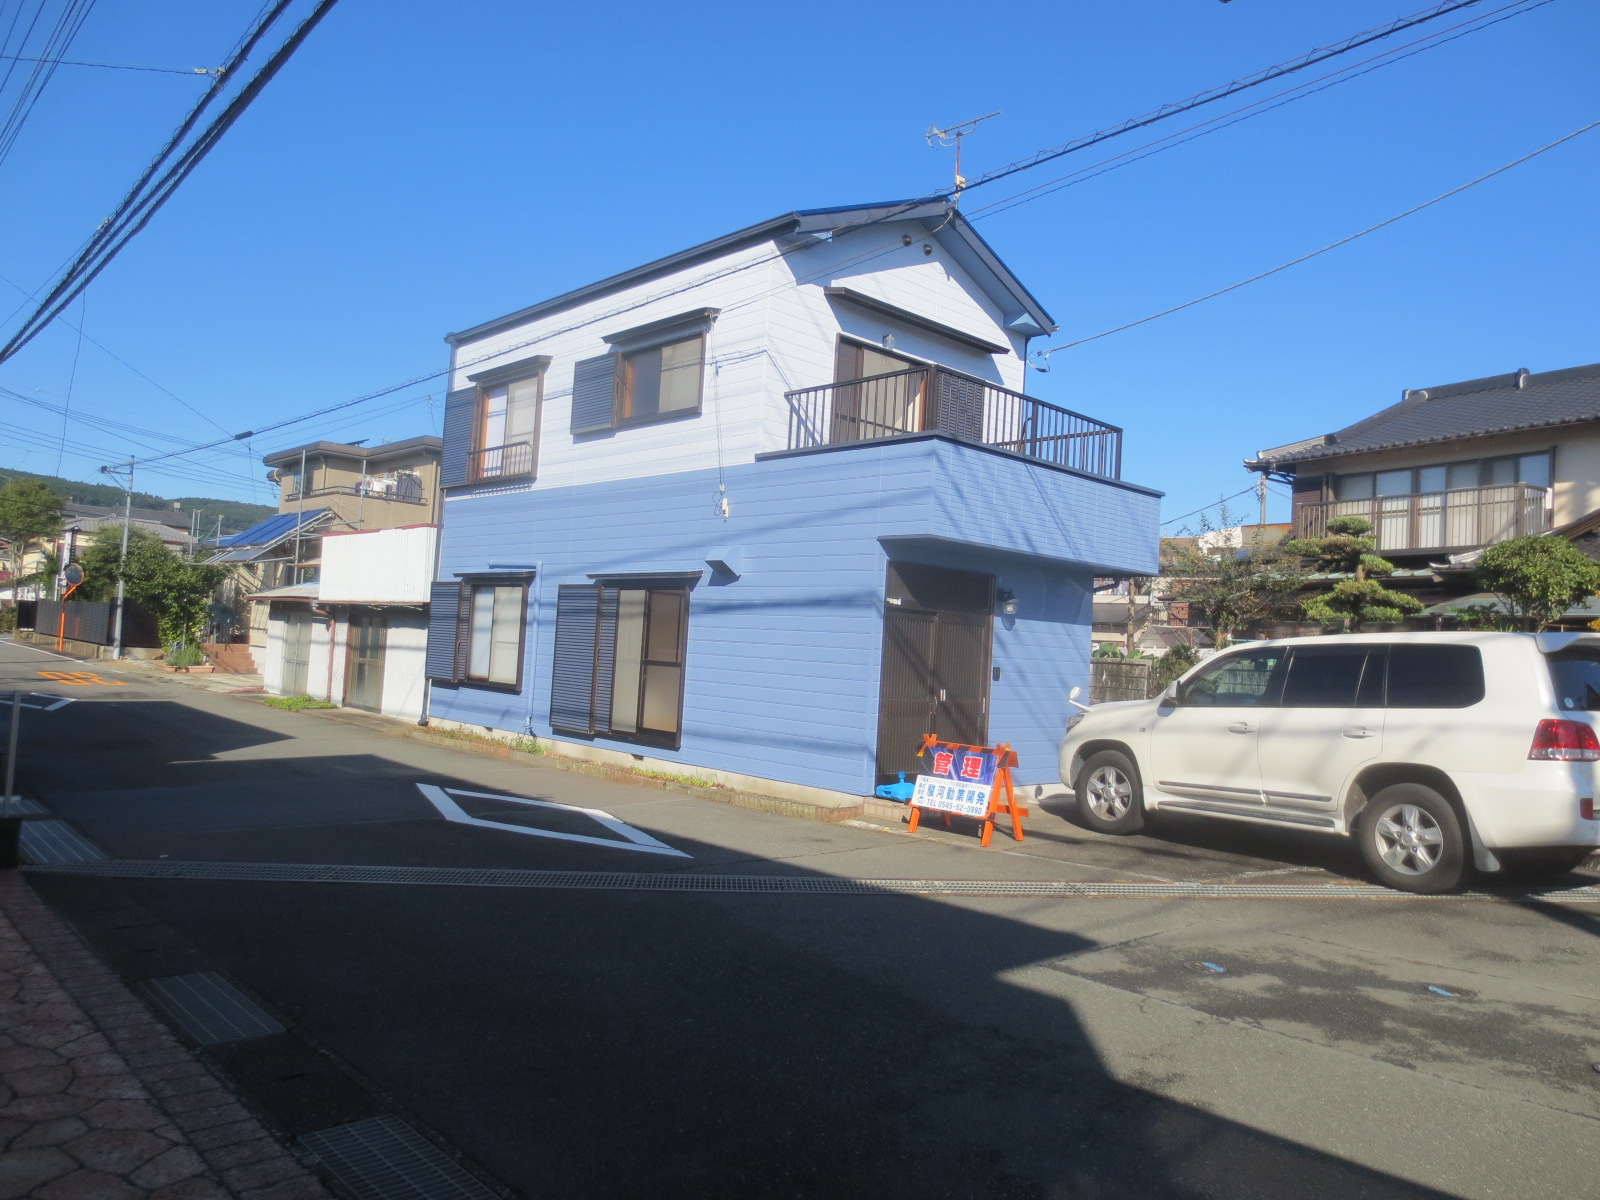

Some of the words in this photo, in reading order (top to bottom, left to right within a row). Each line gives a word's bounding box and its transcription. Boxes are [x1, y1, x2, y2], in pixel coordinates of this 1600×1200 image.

[933, 752, 983, 779] 管理
[927, 798, 936, 807] TEL
[938, 800, 982, 815] 0545-52-0990
